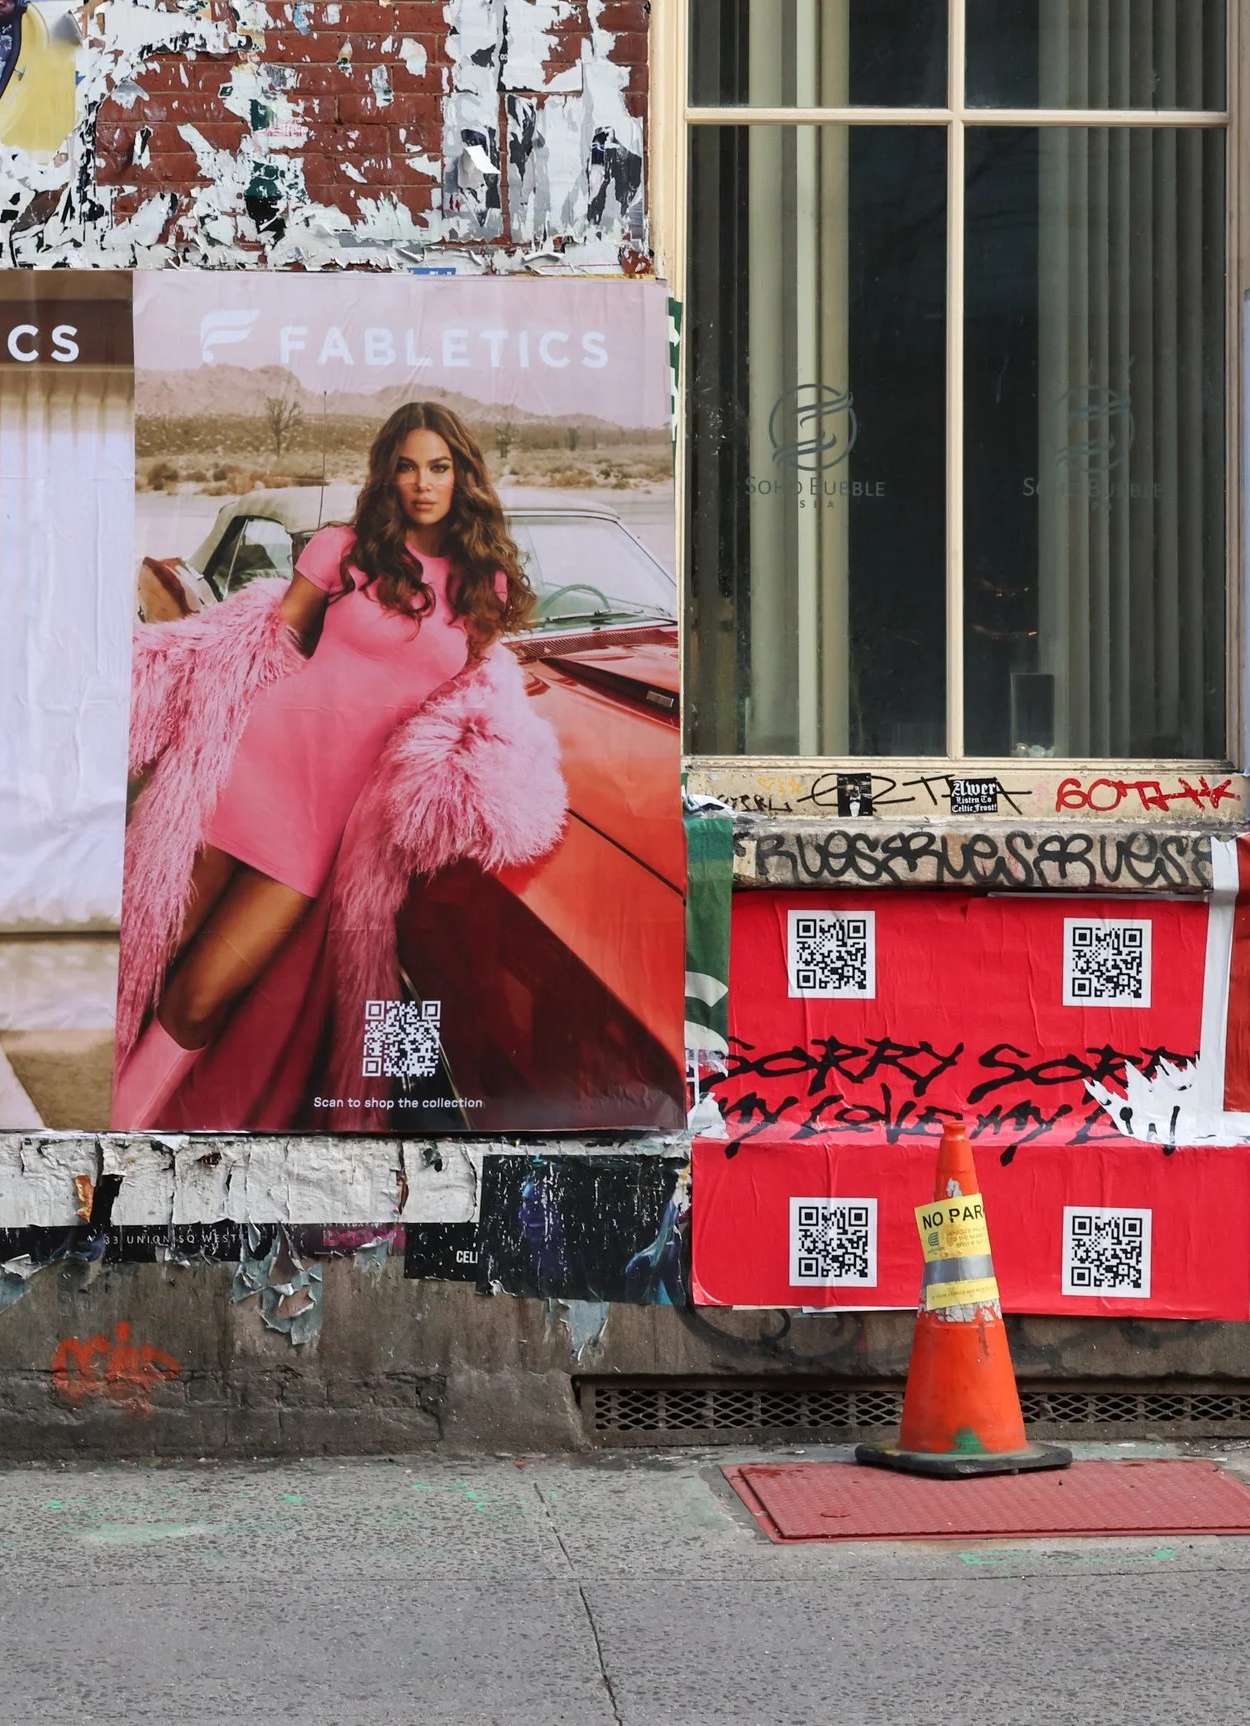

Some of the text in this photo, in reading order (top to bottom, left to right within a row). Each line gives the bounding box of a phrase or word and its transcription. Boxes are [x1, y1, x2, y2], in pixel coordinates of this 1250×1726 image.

[279, 327, 609, 369] FABLETICS
[951, 780, 997, 797] Awer
[955, 795, 992, 804] Listen To
[951, 803, 998, 813] Celtic Frost!
[313, 1096, 483, 1110] Scan to shop the collection
[922, 1204, 985, 1230] NO PAR
[126, 1233, 171, 1245] UNION
[178, 1234, 196, 1244] SQ
